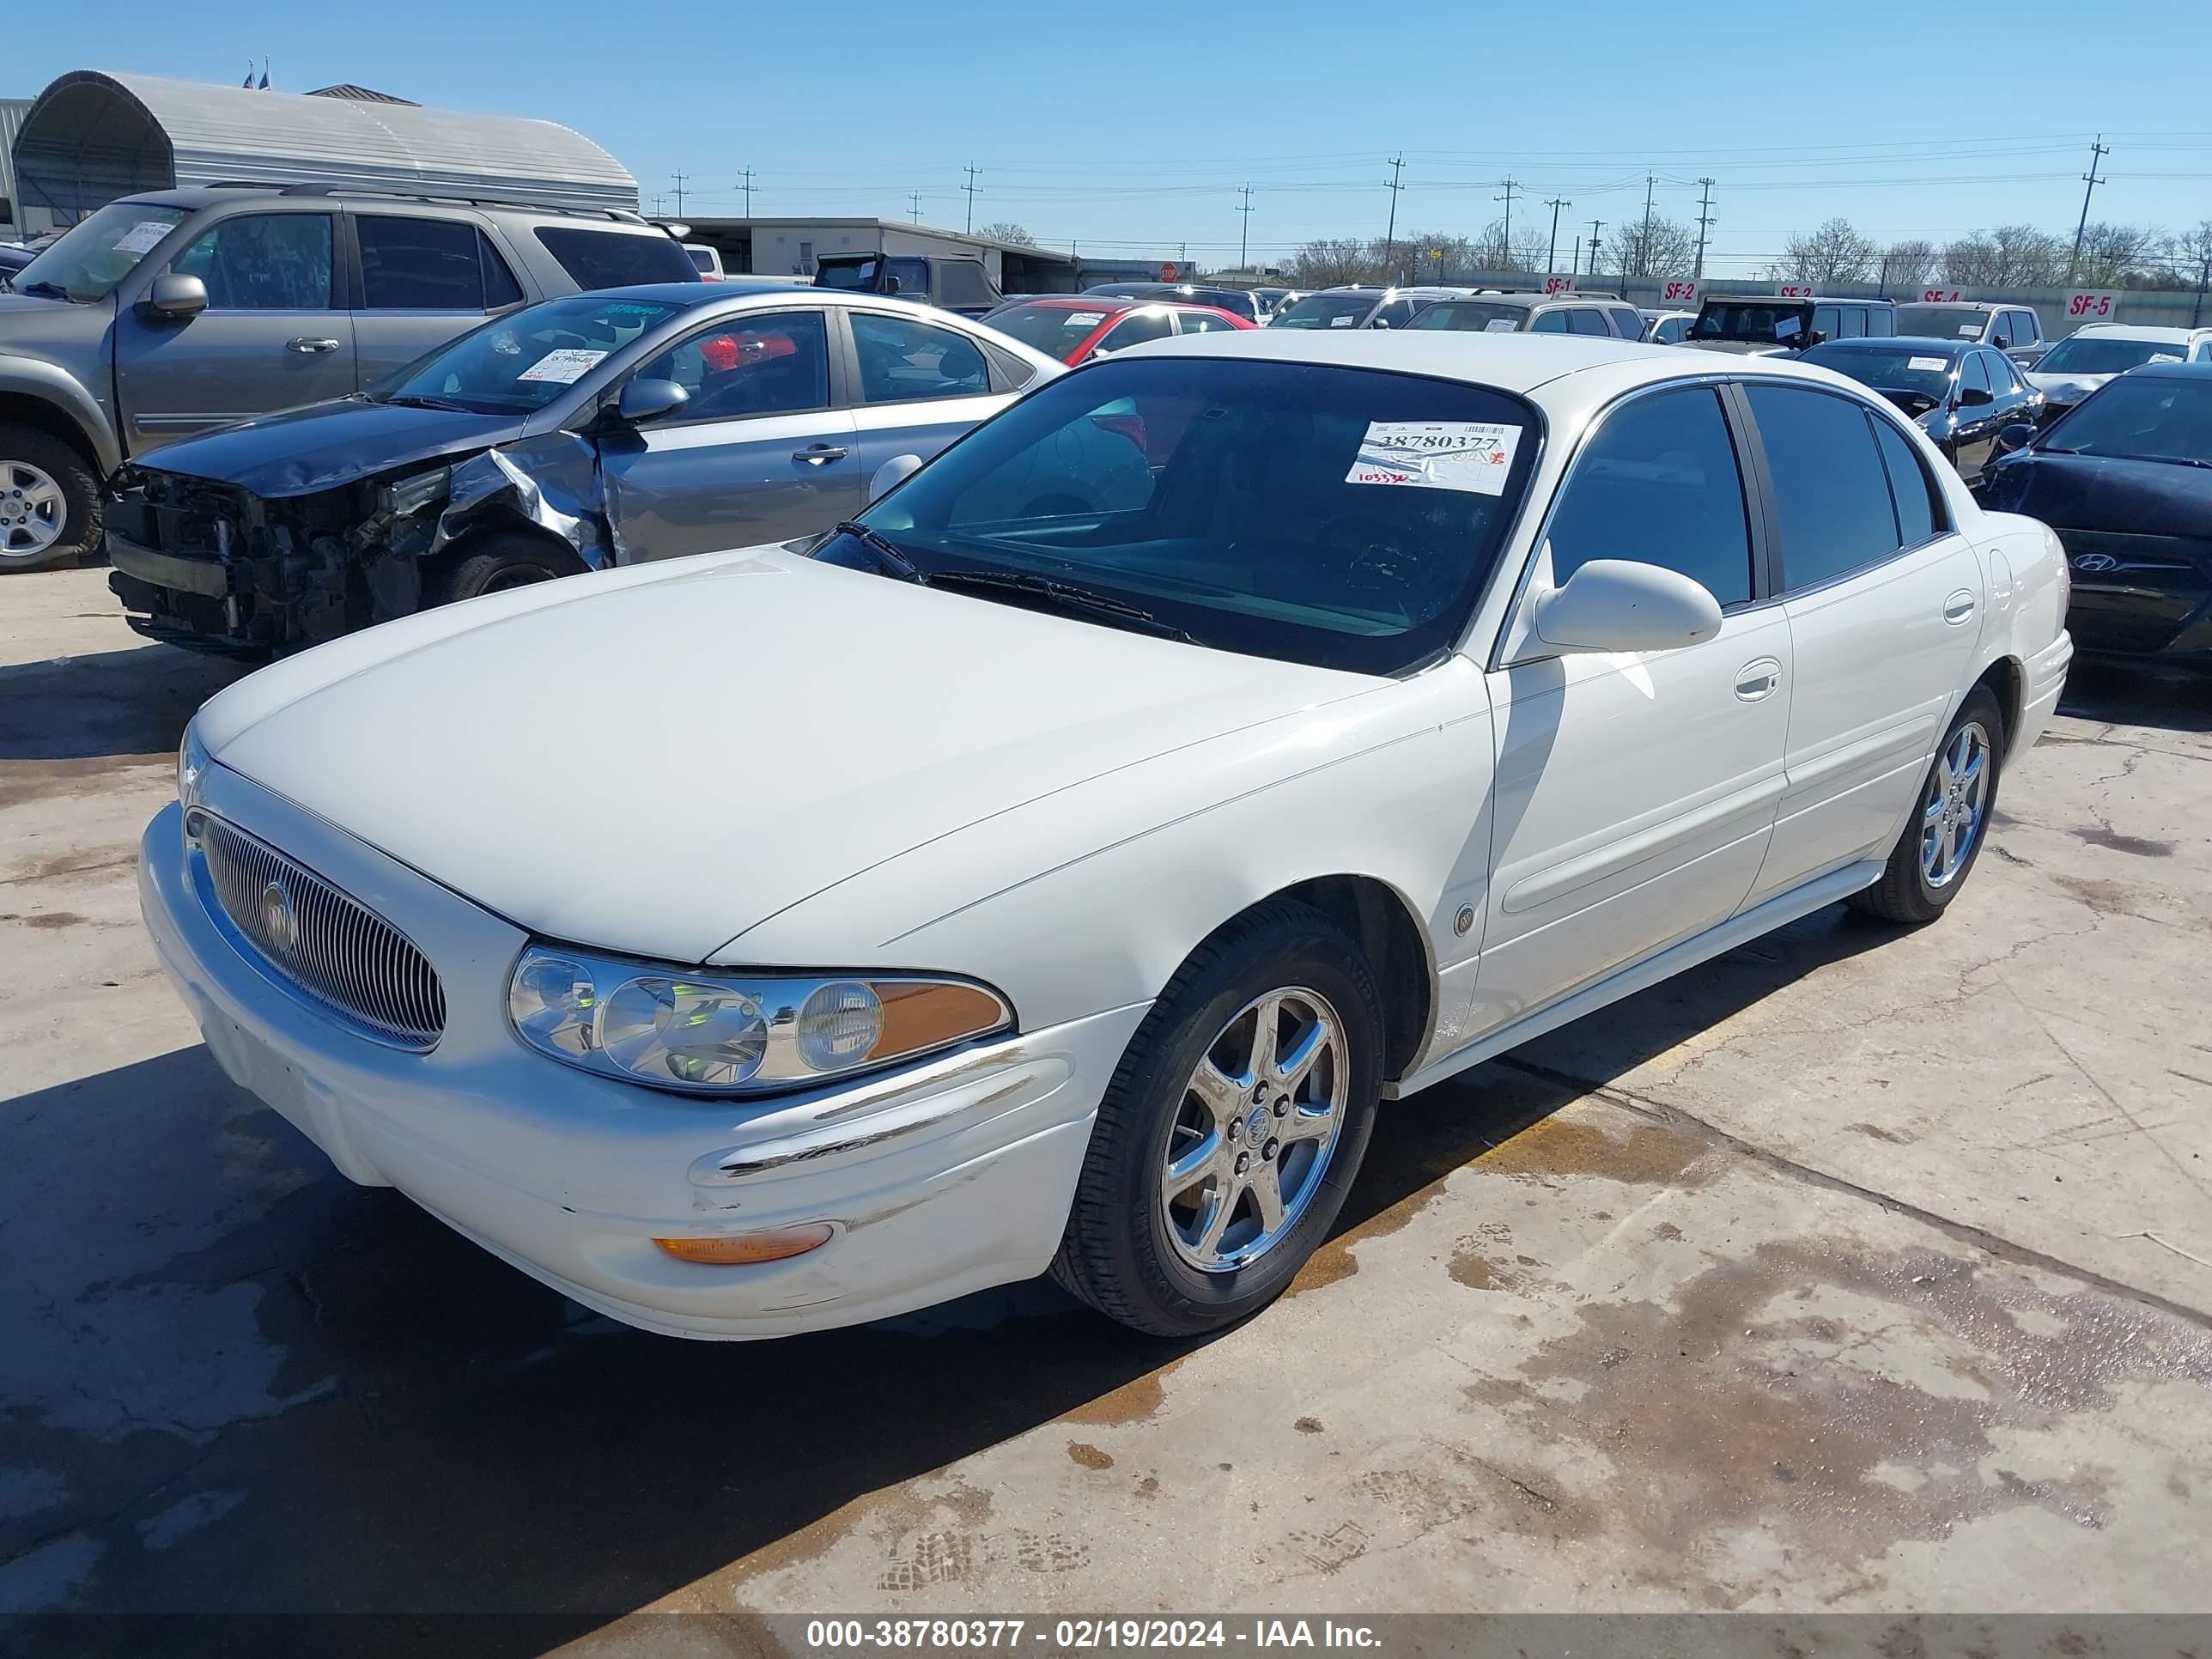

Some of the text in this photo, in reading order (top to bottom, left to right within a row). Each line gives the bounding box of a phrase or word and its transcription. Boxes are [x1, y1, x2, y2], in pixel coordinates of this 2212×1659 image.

[1161, 269, 1176, 279] STOP
[1546, 277, 1571, 294] SF-1
[1664, 282, 1695, 300] SF-2
[2069, 295, 2112, 316] SF-5
[1378, 435, 1499, 451] 38780377
